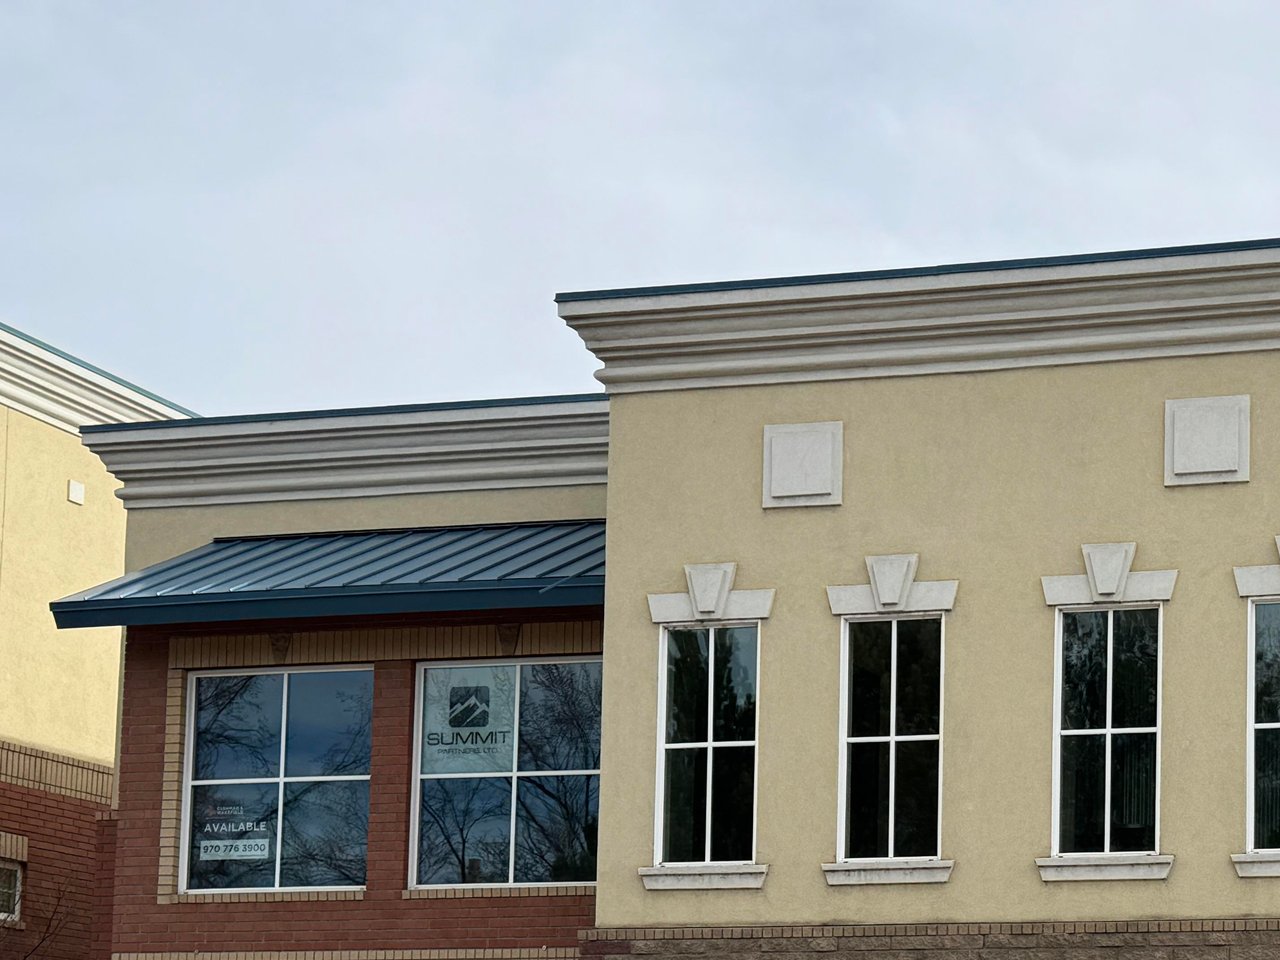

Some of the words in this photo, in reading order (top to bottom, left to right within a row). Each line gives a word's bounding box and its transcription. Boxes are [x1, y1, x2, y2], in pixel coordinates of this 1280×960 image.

[427, 731, 511, 746] SUMMIT
[204, 821, 267, 833] AVAILABLE
[203, 844, 221, 853] 970
[222, 844, 240, 853] 776
[241, 843, 266, 852] 3900
